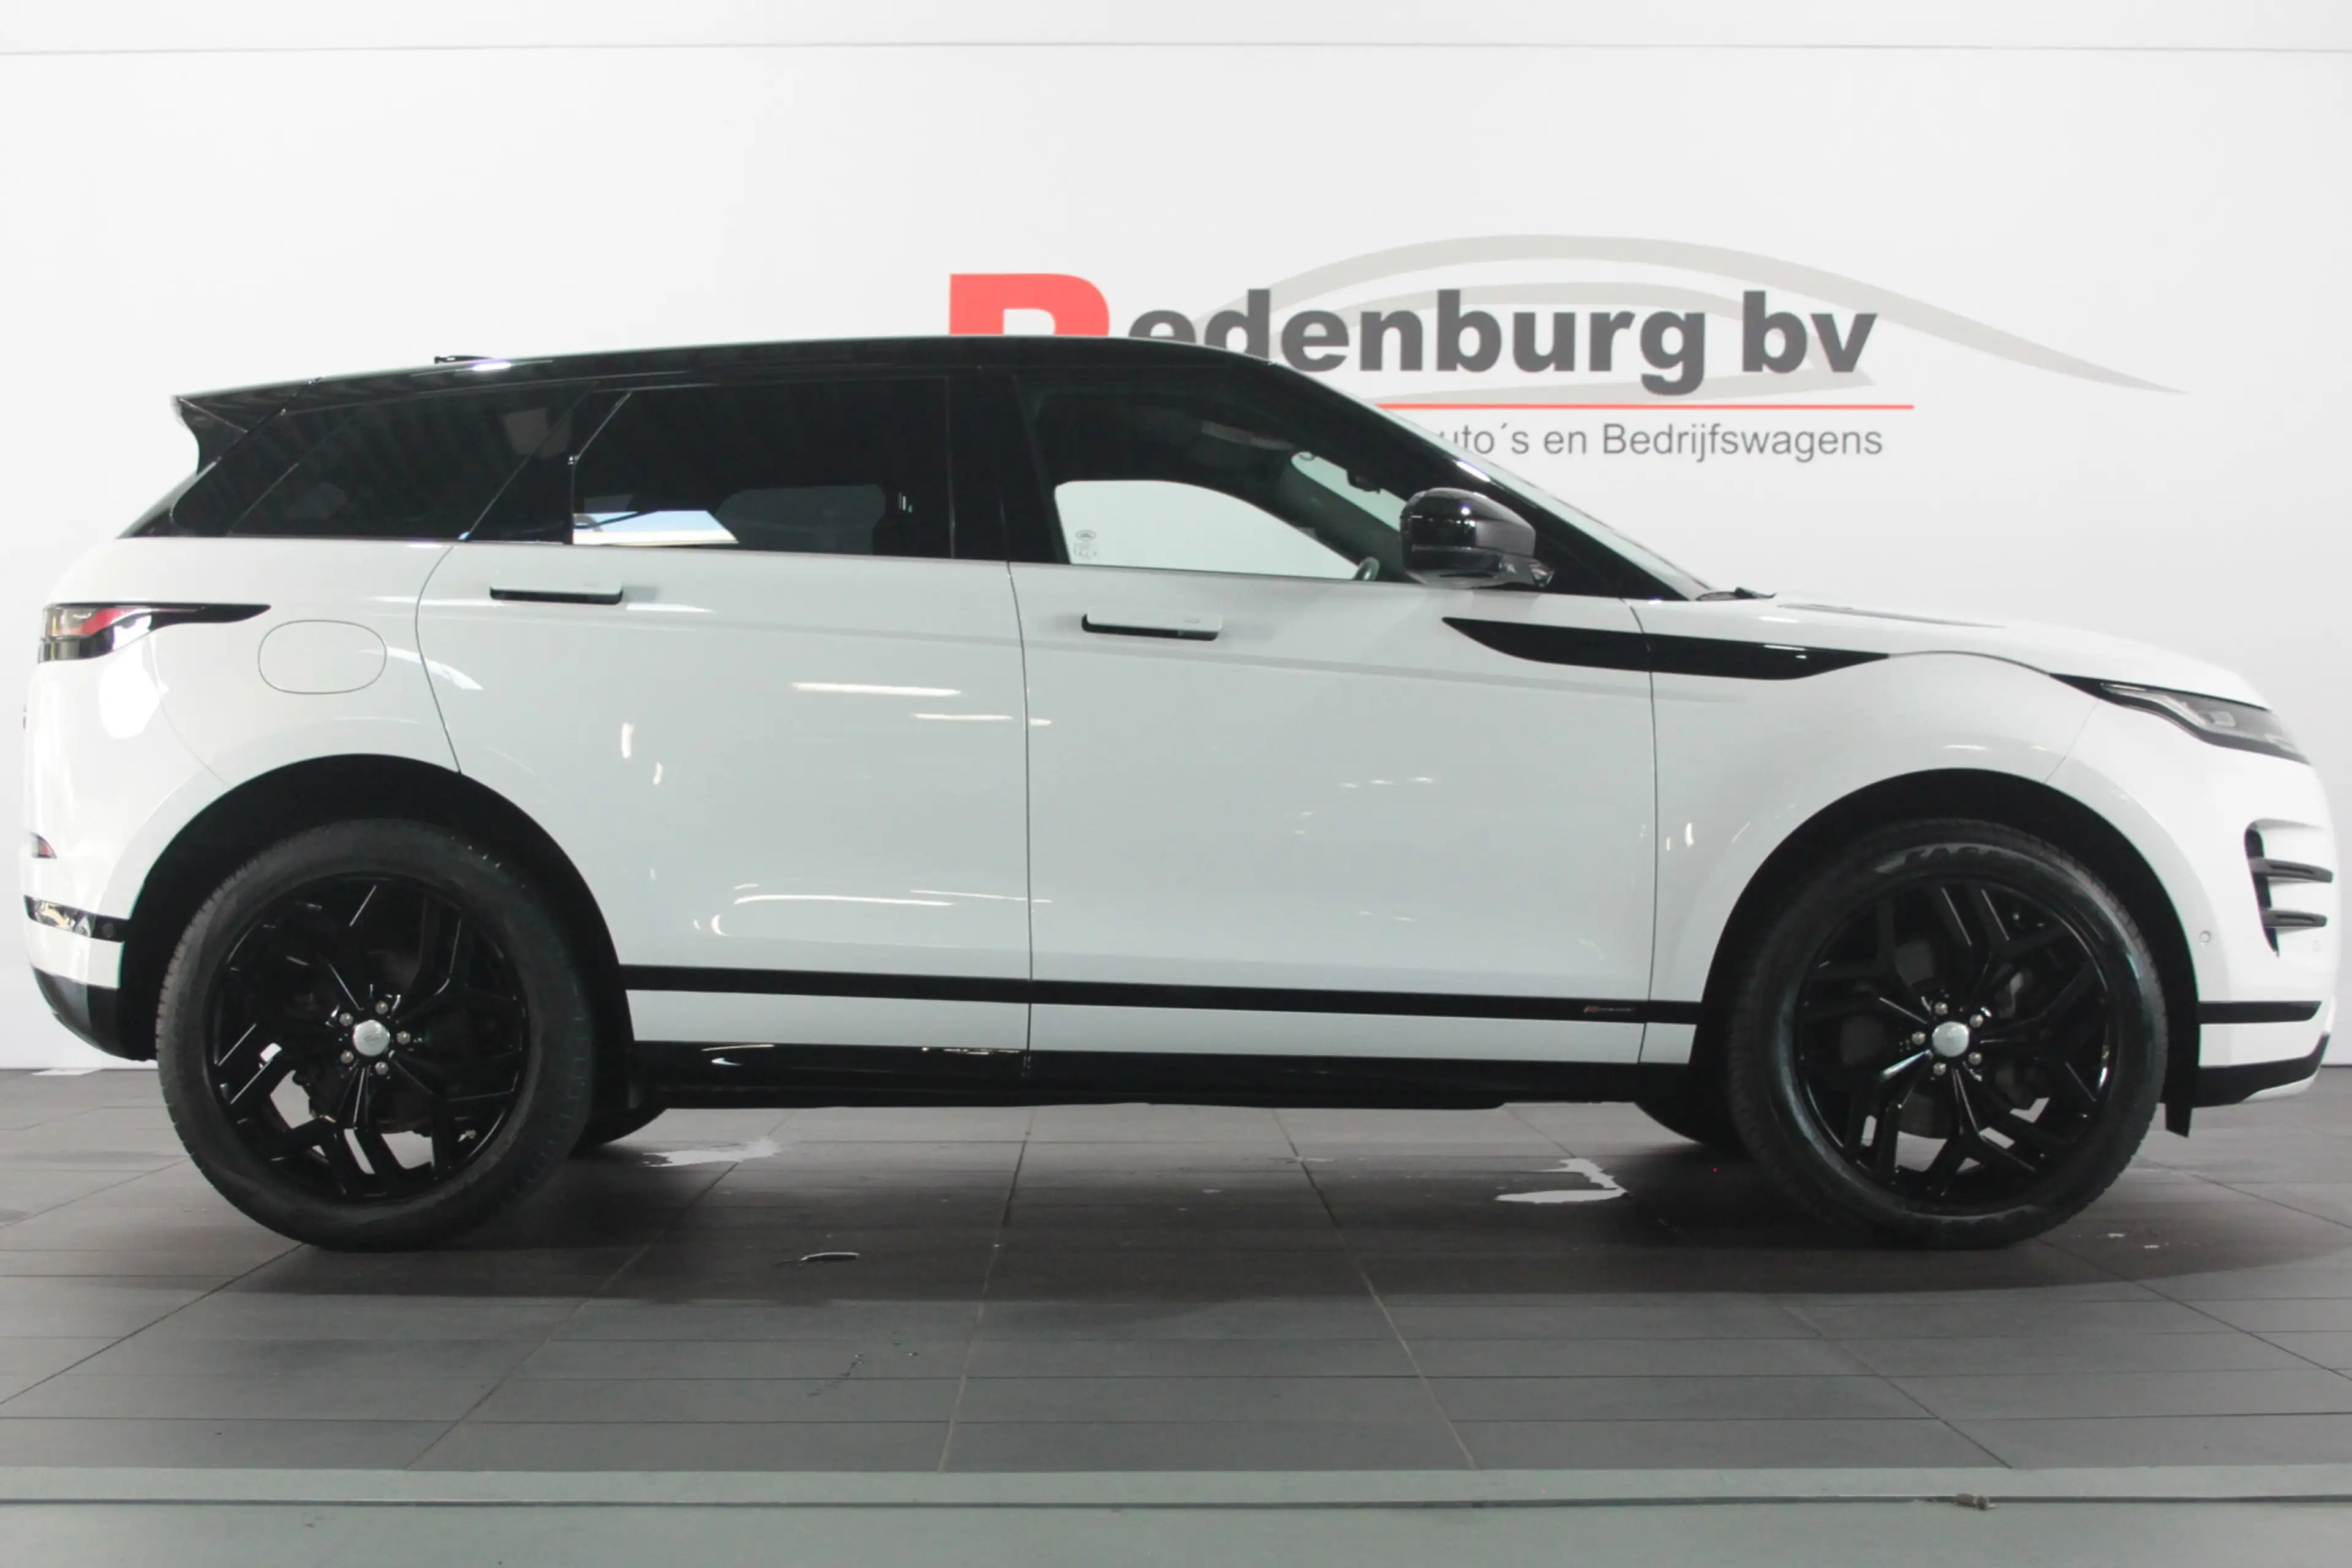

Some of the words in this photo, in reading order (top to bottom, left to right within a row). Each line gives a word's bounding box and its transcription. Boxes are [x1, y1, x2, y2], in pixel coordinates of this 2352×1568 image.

[1743, 291, 1877, 373] bv
[1544, 431, 1586, 454] en
[1603, 423, 1882, 463] Bedrijfswagens
